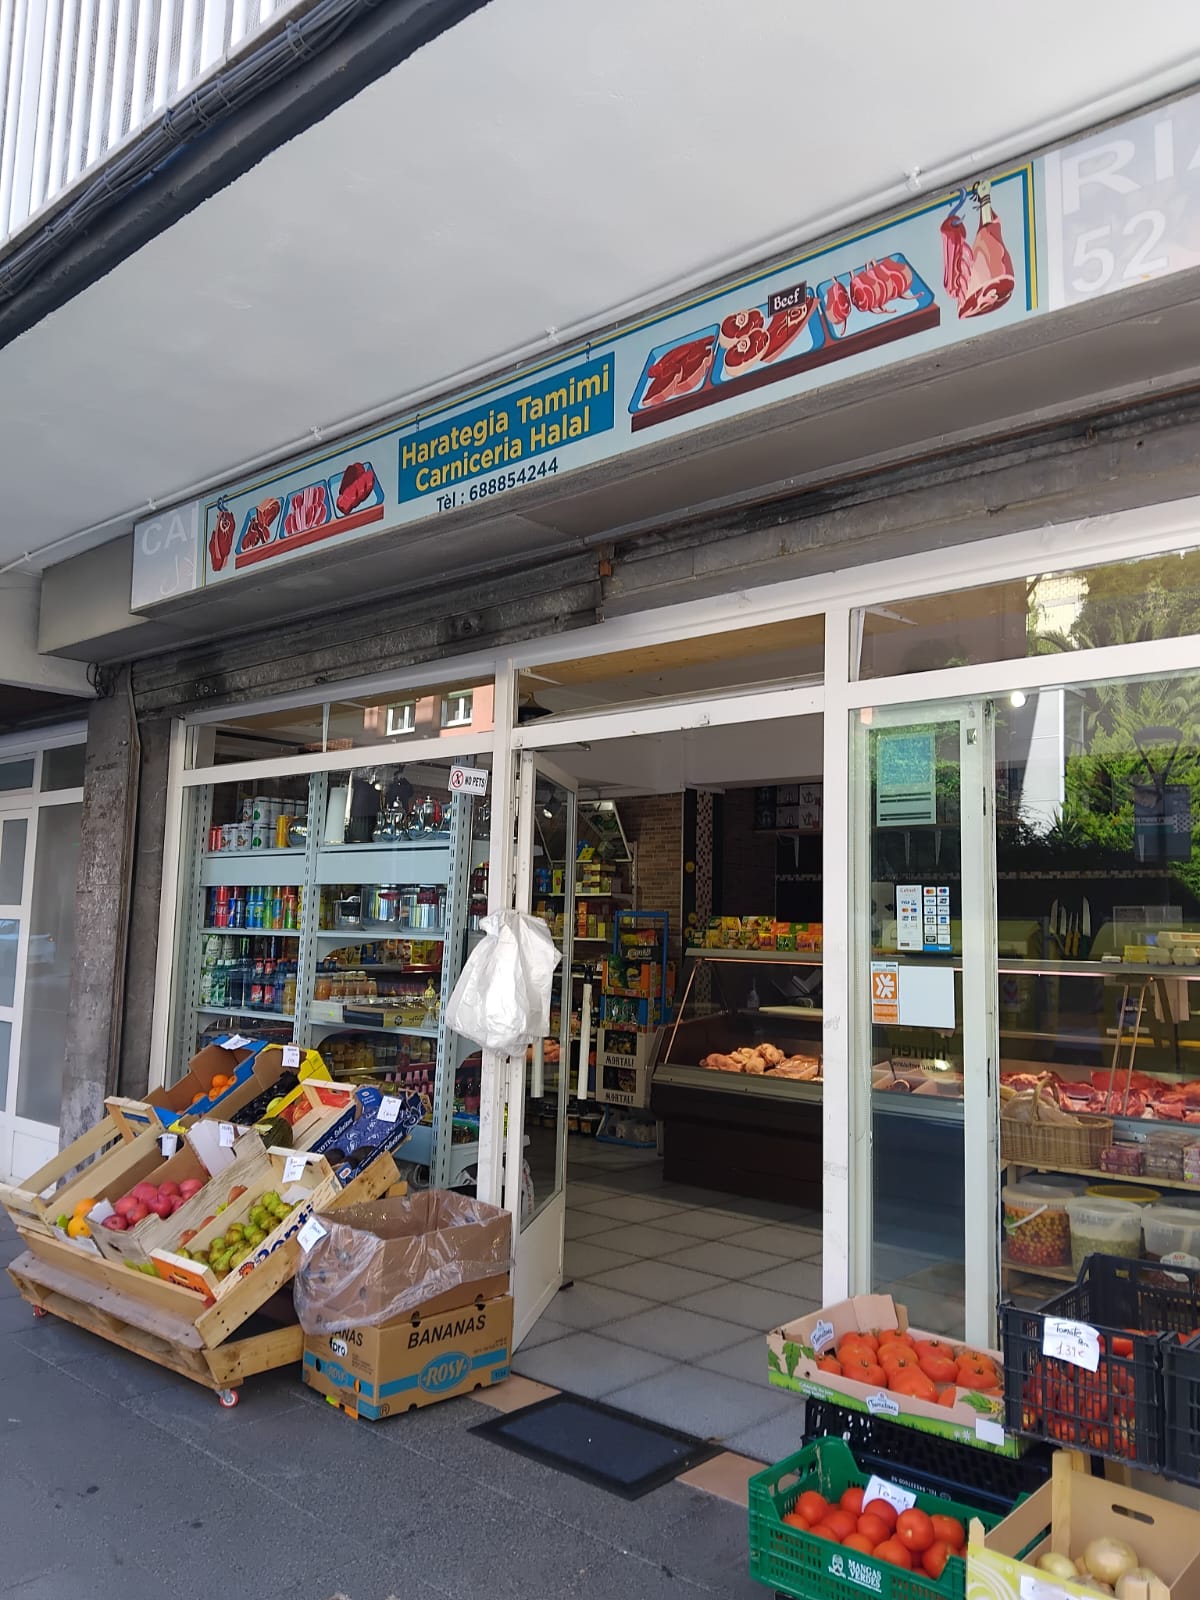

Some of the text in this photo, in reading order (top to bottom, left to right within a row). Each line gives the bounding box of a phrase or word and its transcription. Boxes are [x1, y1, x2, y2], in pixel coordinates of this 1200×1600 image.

[1061, 120, 1200, 217] RI
[1070, 210, 1169, 292] 52
[773, 287, 800, 311] Beef
[401, 363, 609, 470] Harategia Tamimi
[415, 405, 590, 492] Carniceria Halal
[436, 489, 456, 512] Tèl
[469, 456, 559, 501] 688854244
[464, 776, 485, 788] NO PETS
[407, 1314, 486, 1350] BANANAS
[426, 1358, 464, 1387] ROSY
[848, 1559, 882, 1580] MANGAS
[850, 1567, 881, 1589] VERDES
